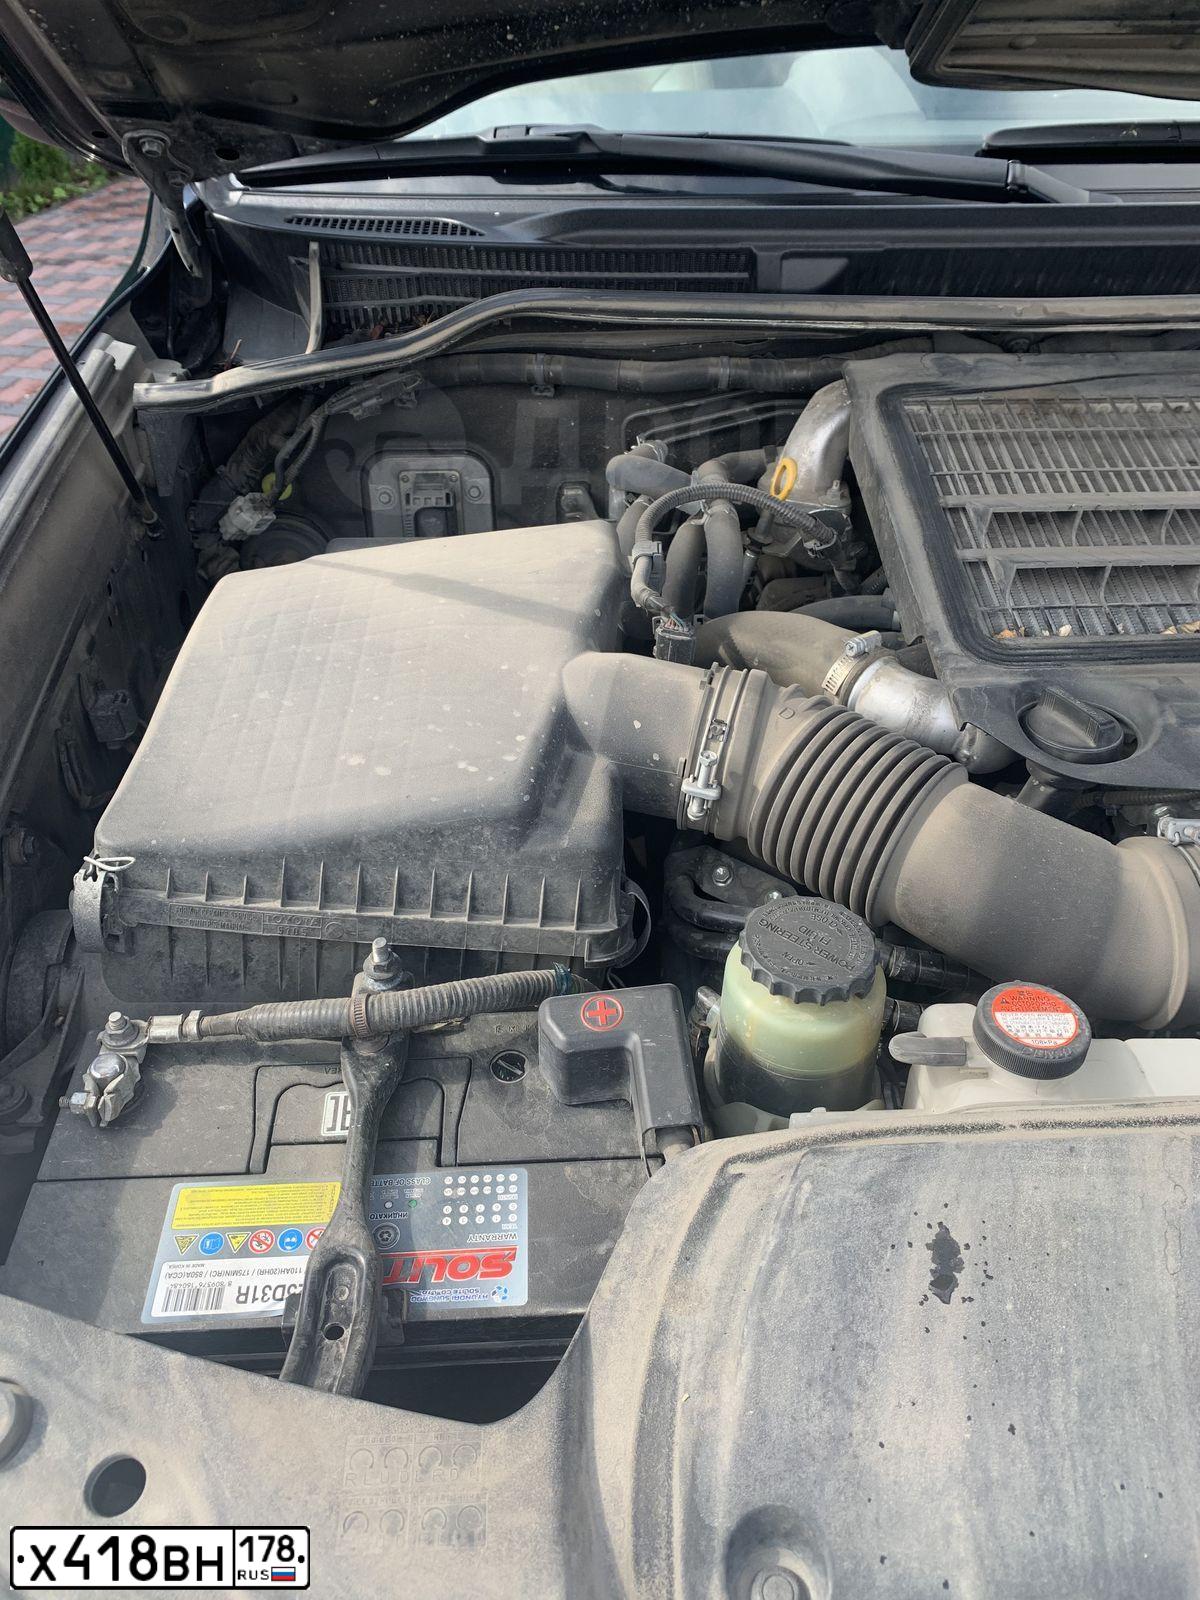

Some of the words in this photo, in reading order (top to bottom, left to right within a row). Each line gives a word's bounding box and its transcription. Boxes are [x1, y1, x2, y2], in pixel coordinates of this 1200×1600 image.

[266, 914, 319, 927] TOYOTA
[810, 913, 838, 929] CLOSE
[757, 918, 814, 951] STEERING
[798, 925, 832, 946] FLUID
[780, 952, 804, 967] OPEN
[814, 946, 855, 971] POWER
[1010, 995, 1050, 1003] WARNING
[369, 1178, 394, 1187] BATTE
[369, 1211, 409, 1220] ИНДИКАТО
[467, 1232, 518, 1242] WARRANTY
[257, 1267, 303, 1277] 110AH(20HR)
[383, 1251, 516, 1285] SOLIT
[164, 1270, 203, 1280] 850A(CCA)
[209, 1269, 250, 1279] 175MIN(RC)
[235, 1283, 303, 1305] 5D31R
[410, 1295, 450, 1303] SUNGWOO
[451, 1293, 489, 1302] HYUNDAI
